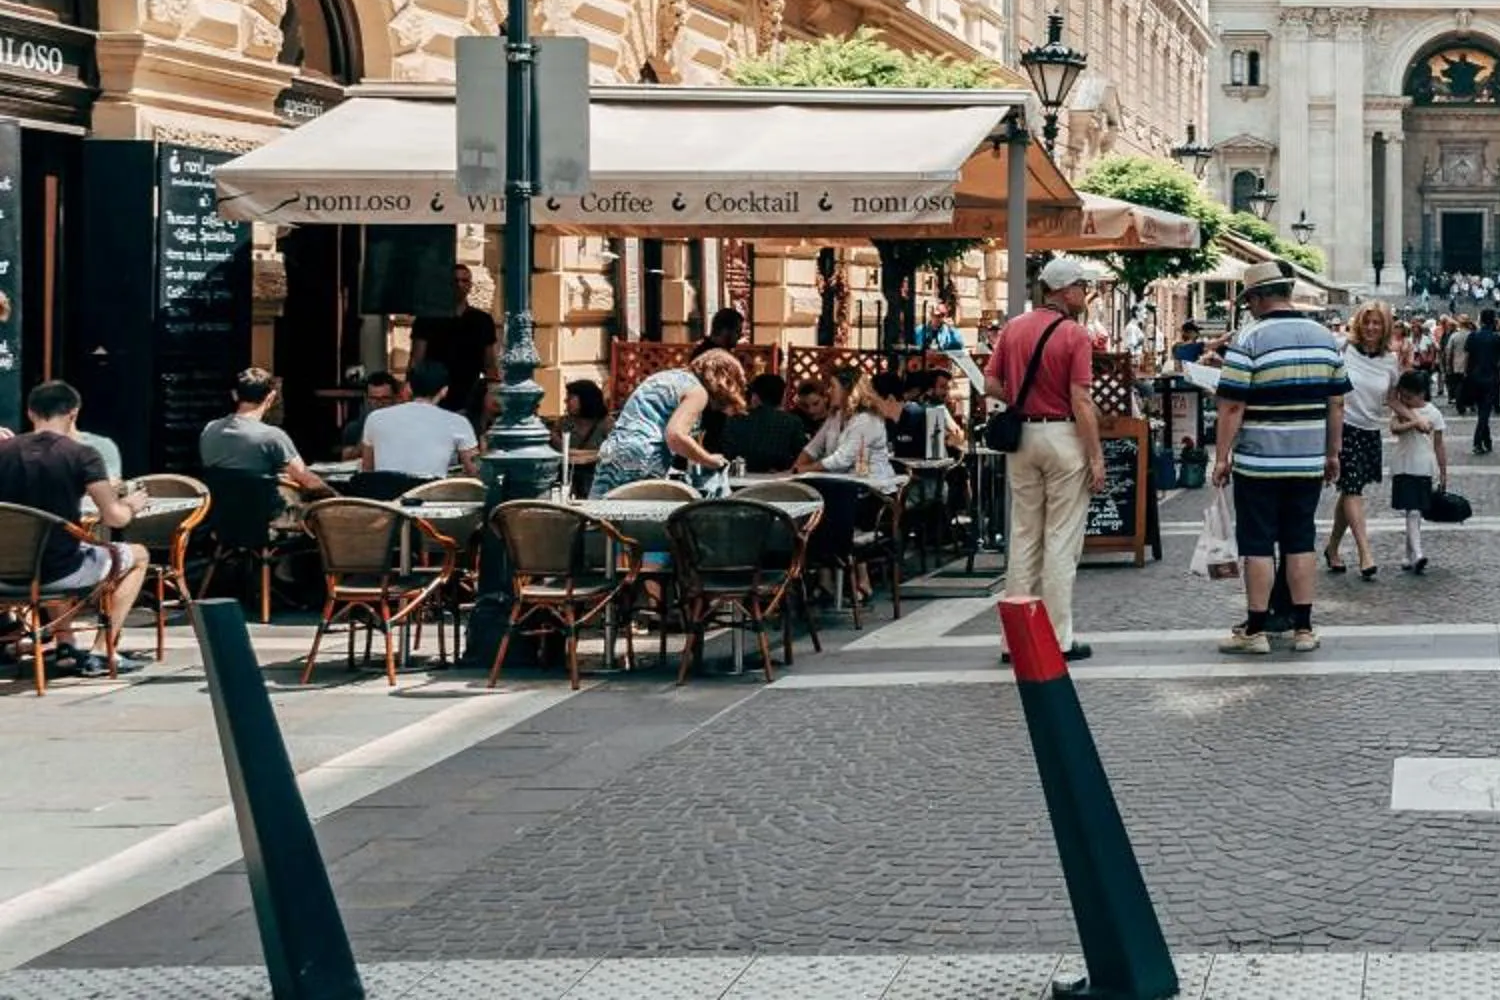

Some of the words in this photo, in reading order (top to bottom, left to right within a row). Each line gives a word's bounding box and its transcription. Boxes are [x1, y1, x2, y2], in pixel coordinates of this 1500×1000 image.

[0, 37, 63, 75] LOSO
[467, 194, 505, 212] Wi
[580, 191, 653, 213] Coffee
[705, 191, 799, 213] Cocktail
